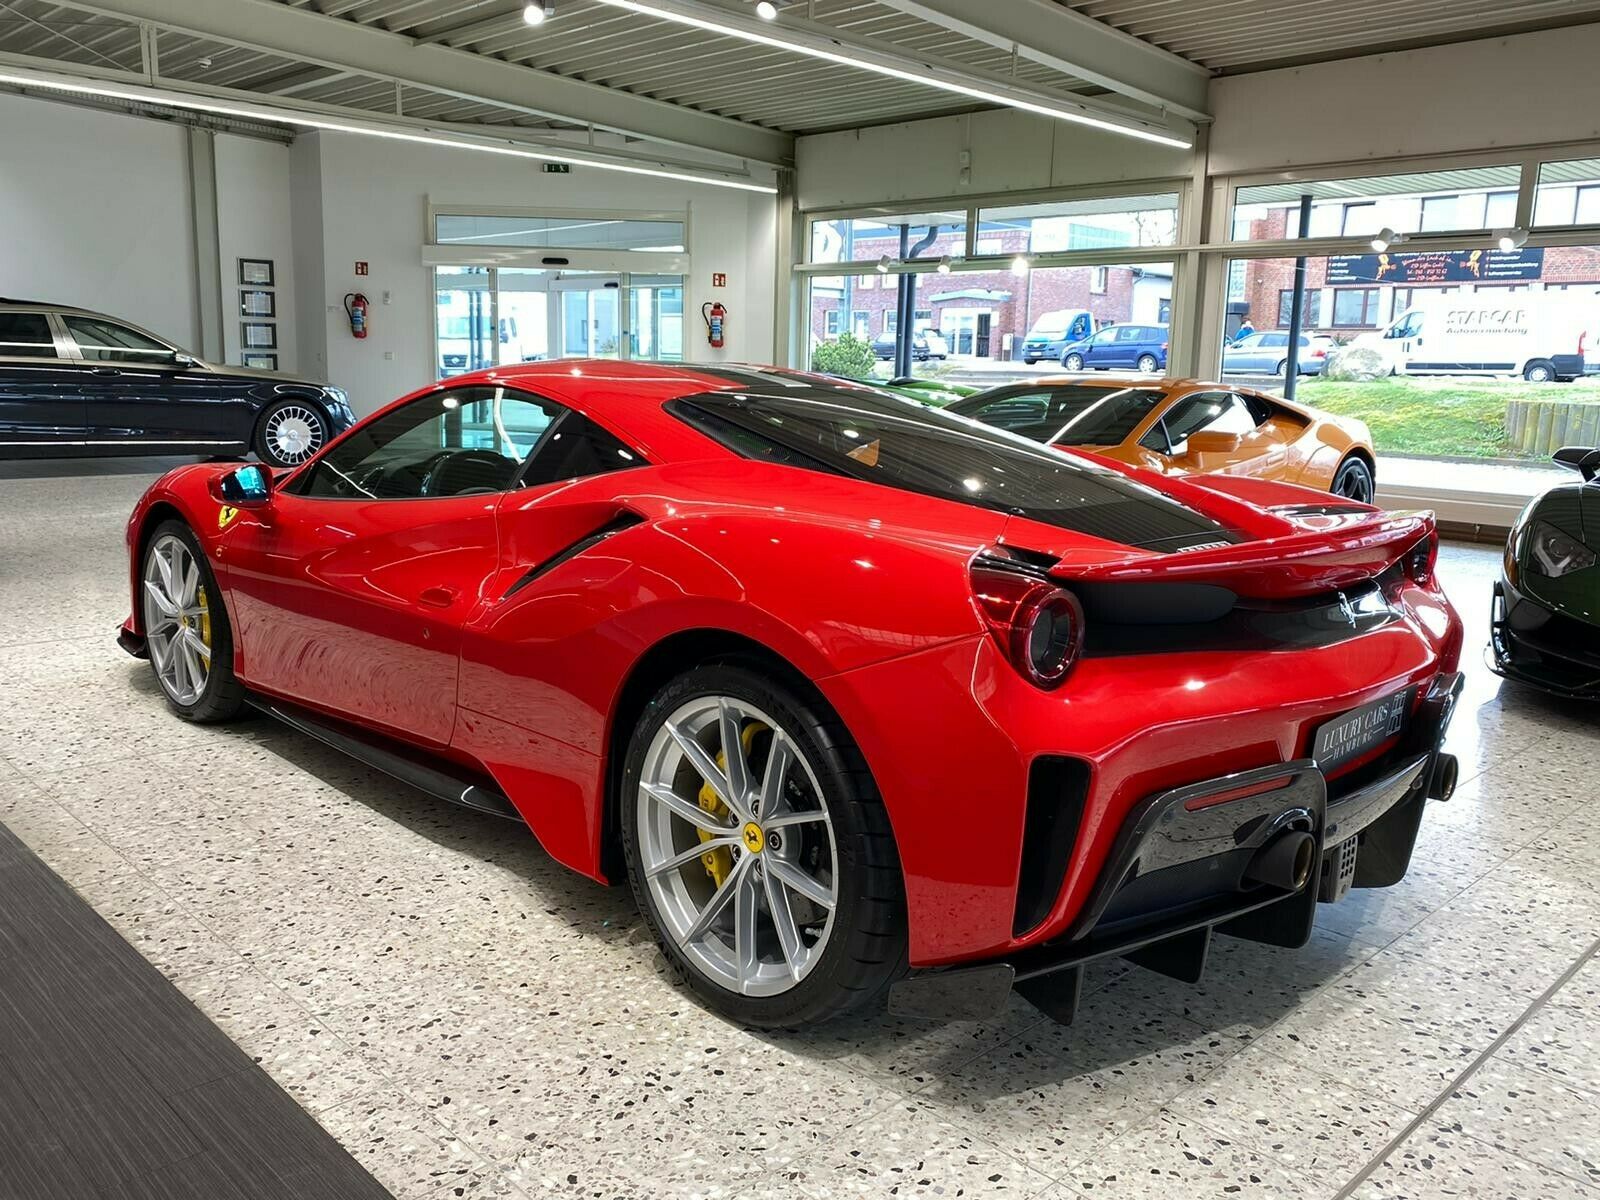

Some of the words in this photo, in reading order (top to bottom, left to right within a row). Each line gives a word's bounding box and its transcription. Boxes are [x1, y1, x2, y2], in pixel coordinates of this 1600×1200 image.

[1322, 716, 1363, 753] LUXURY
[1364, 702, 1390, 730] CARS
[1333, 729, 1374, 760] HAMBURG
